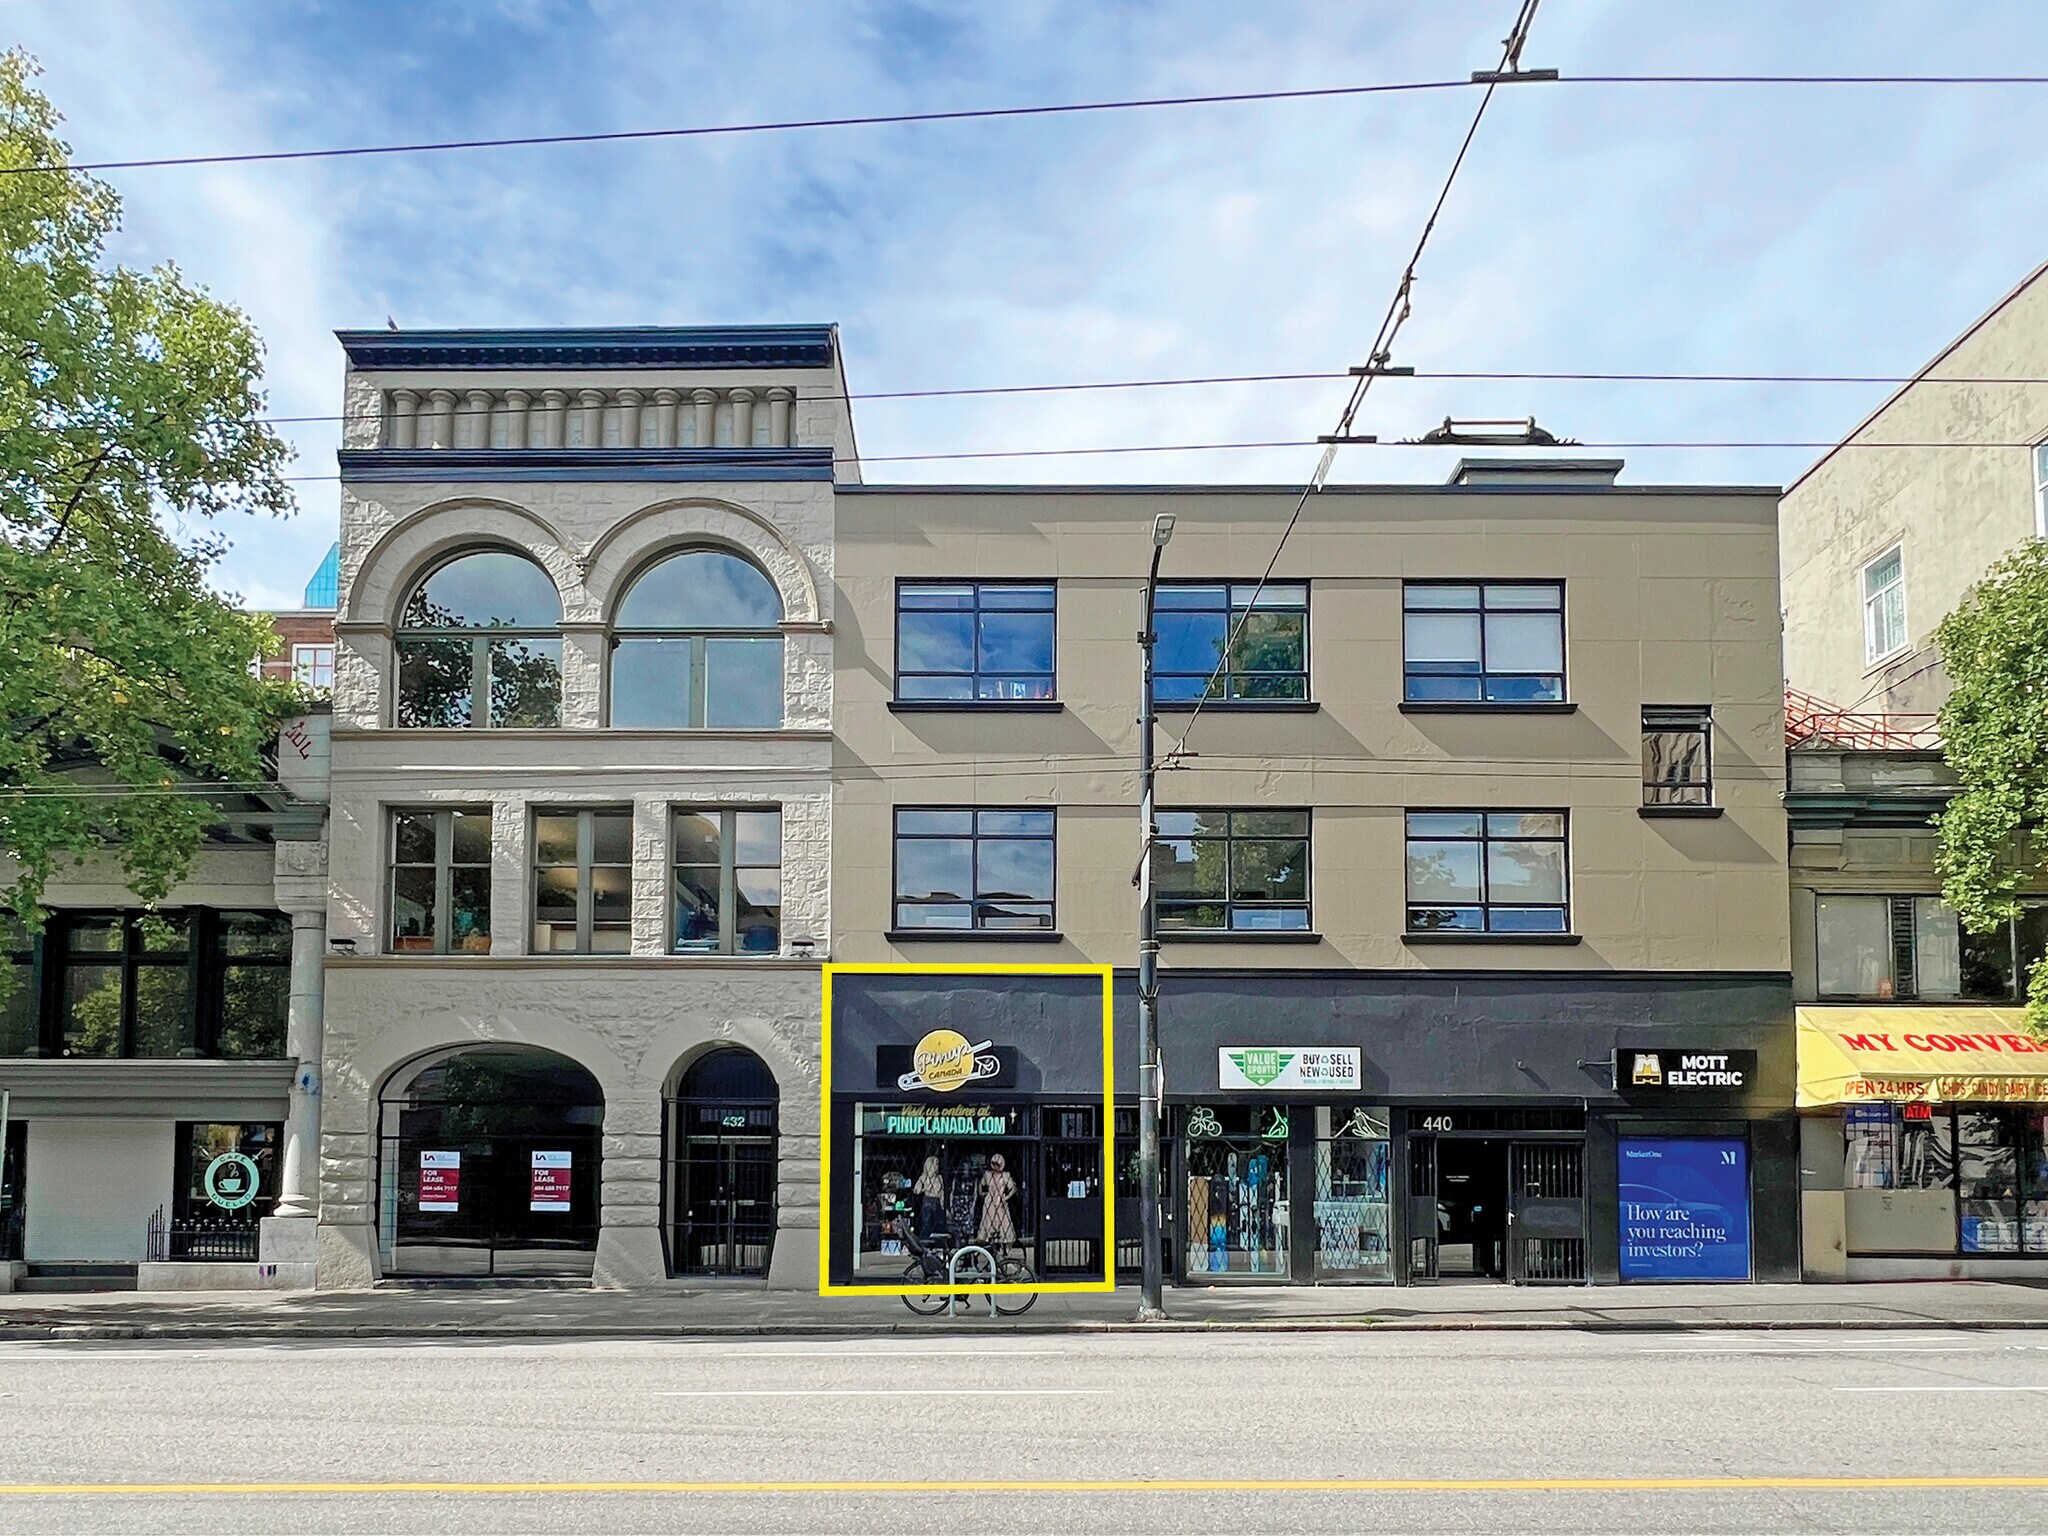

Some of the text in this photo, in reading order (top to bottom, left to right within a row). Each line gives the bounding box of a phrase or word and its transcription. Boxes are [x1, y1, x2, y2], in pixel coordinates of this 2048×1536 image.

[1839, 1034, 1898, 1051] MY
[917, 1044, 971, 1075] Pinup
[1247, 1052, 1277, 1065] VALUE
[1303, 1053, 1353, 1065] BUY SELL
[1682, 1055, 1728, 1070] MOTT
[928, 1067, 962, 1080] CANADA
[1247, 1065, 1277, 1075] SPORTS
[1300, 1066, 1354, 1078] NEW USED
[1668, 1071, 1743, 1085] ELECTRIC
[1845, 1081, 1875, 1096] OPEN
[1878, 1081, 1894, 1095] 24
[901, 1103, 991, 1117] Visit us online at
[1906, 1105, 1931, 1119] ATM
[722, 1116, 746, 1128] 432
[887, 1116, 1006, 1134] PINUPCANADA.COM
[1423, 1116, 1453, 1131] 440
[1626, 1150, 1662, 1158] MarketOne
[423, 1169, 438, 1177] FOR
[534, 1169, 548, 1177] FOR
[1627, 1204, 1690, 1221] How are
[1627, 1222, 1727, 1244] you reaching
[1628, 1241, 1704, 1257] investors?
